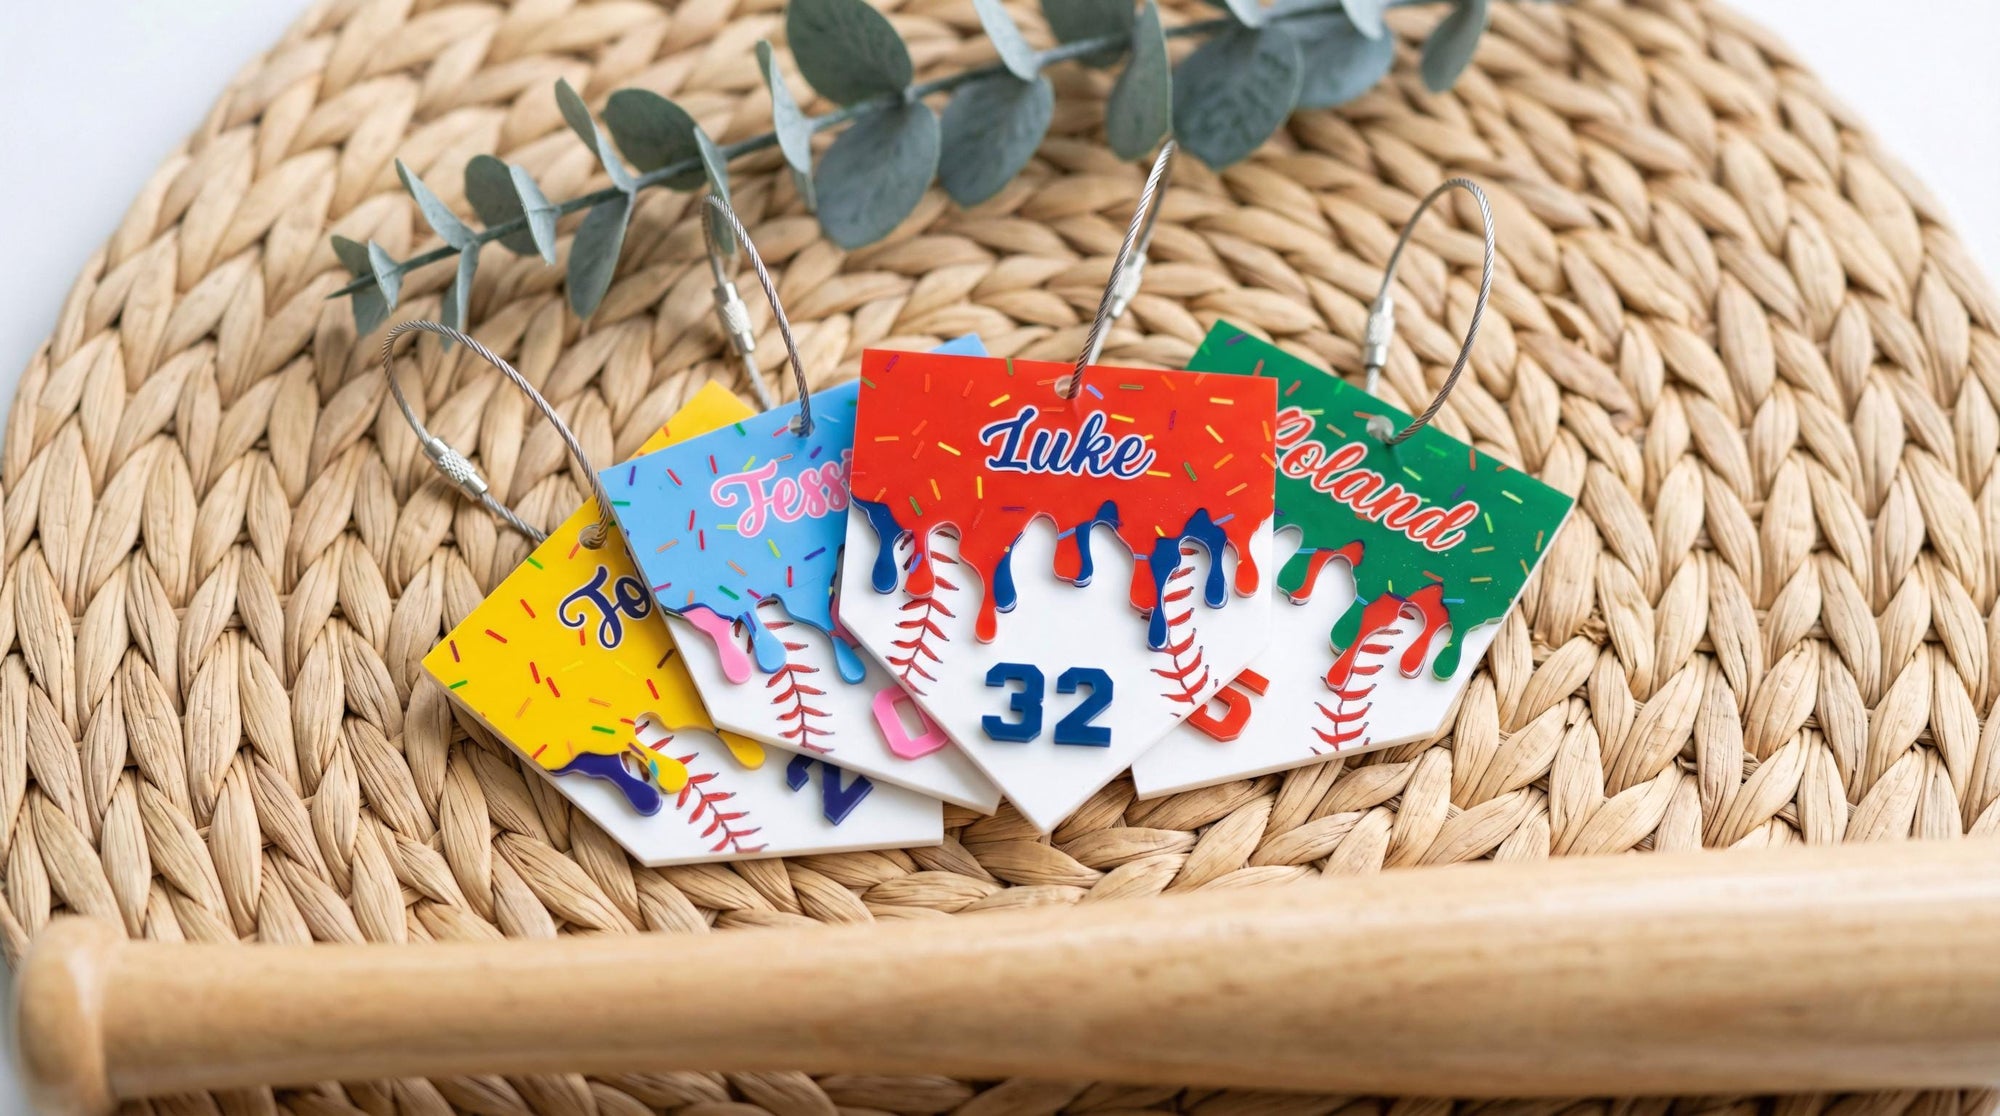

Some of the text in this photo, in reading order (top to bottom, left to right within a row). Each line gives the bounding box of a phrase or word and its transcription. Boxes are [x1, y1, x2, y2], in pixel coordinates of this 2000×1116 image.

[980, 406, 1156, 479] Luke
[558, 546, 653, 650] Jo
[982, 662, 1114, 748] 32
[787, 754, 874, 826] 2
